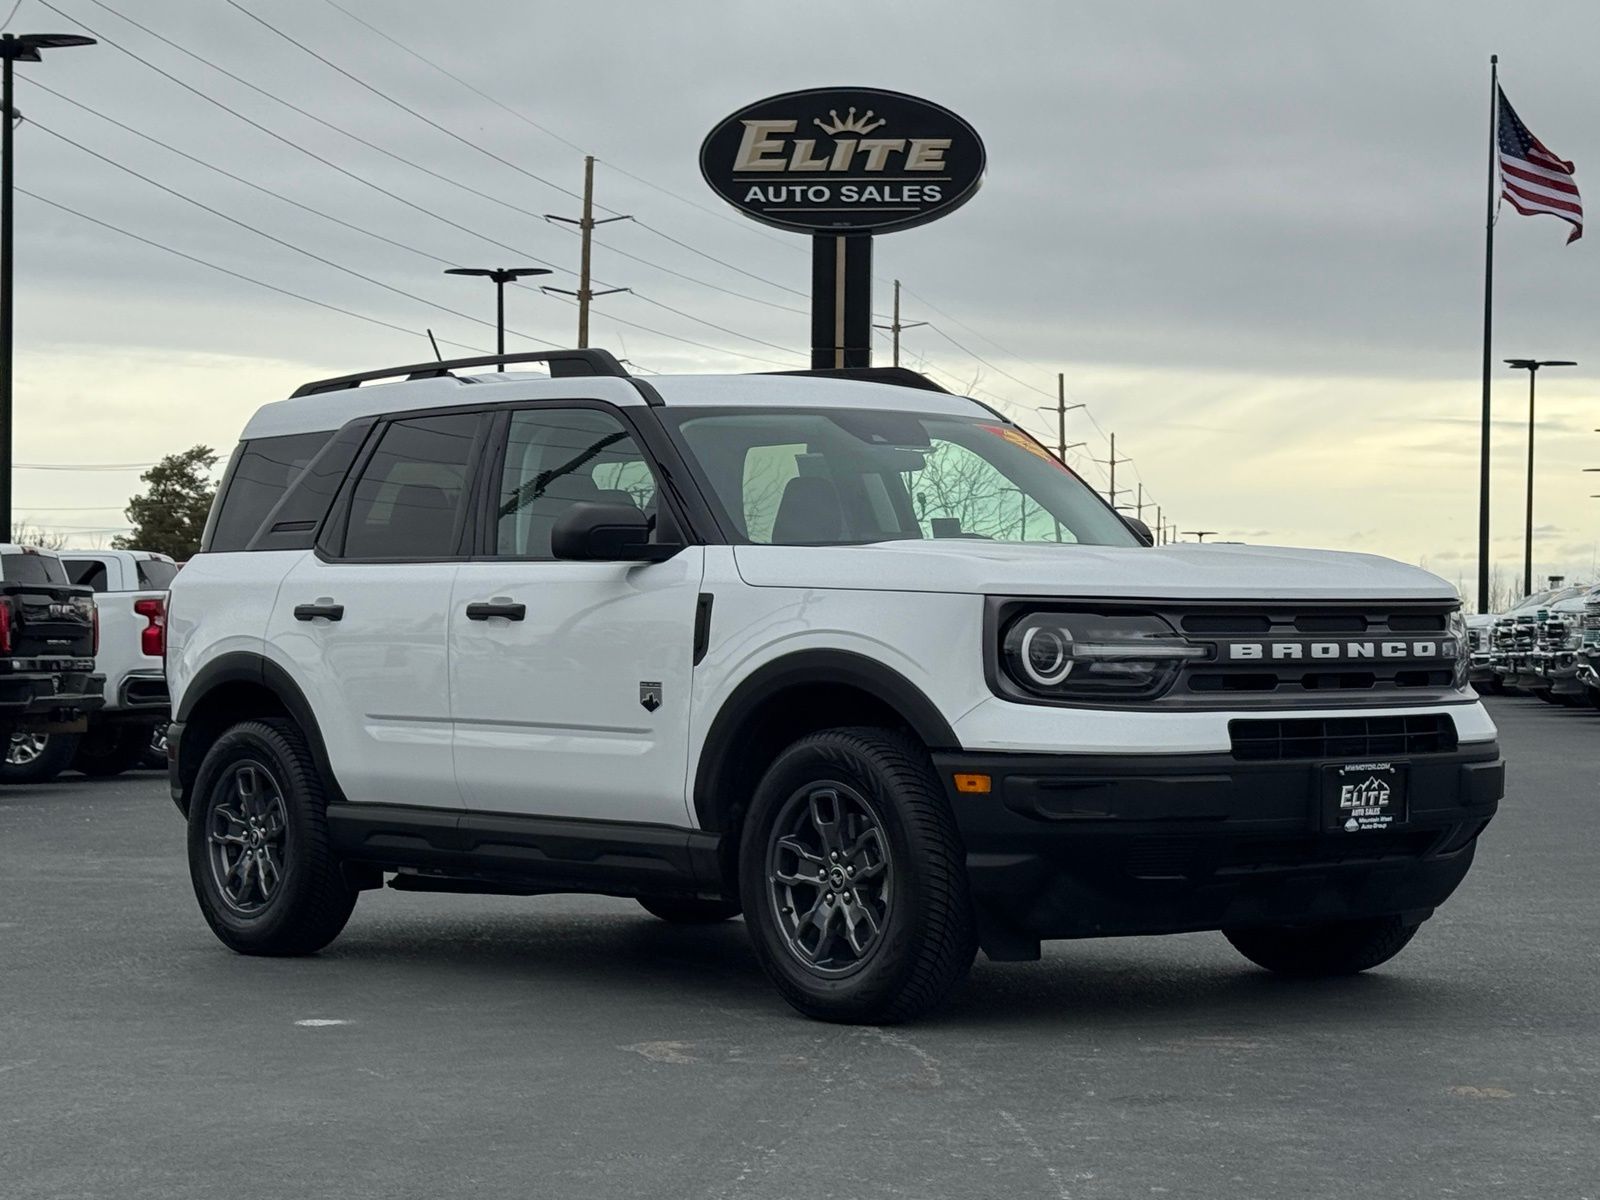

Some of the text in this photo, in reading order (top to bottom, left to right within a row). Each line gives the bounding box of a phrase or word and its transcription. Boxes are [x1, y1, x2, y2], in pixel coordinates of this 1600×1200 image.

[732, 119, 953, 172] ELITE
[744, 185, 942, 203] AUTO SALES
[1229, 641, 1436, 659] BRONCO
[1340, 785, 1391, 808] ELITE
[1352, 807, 1380, 816] AUTO SALES
